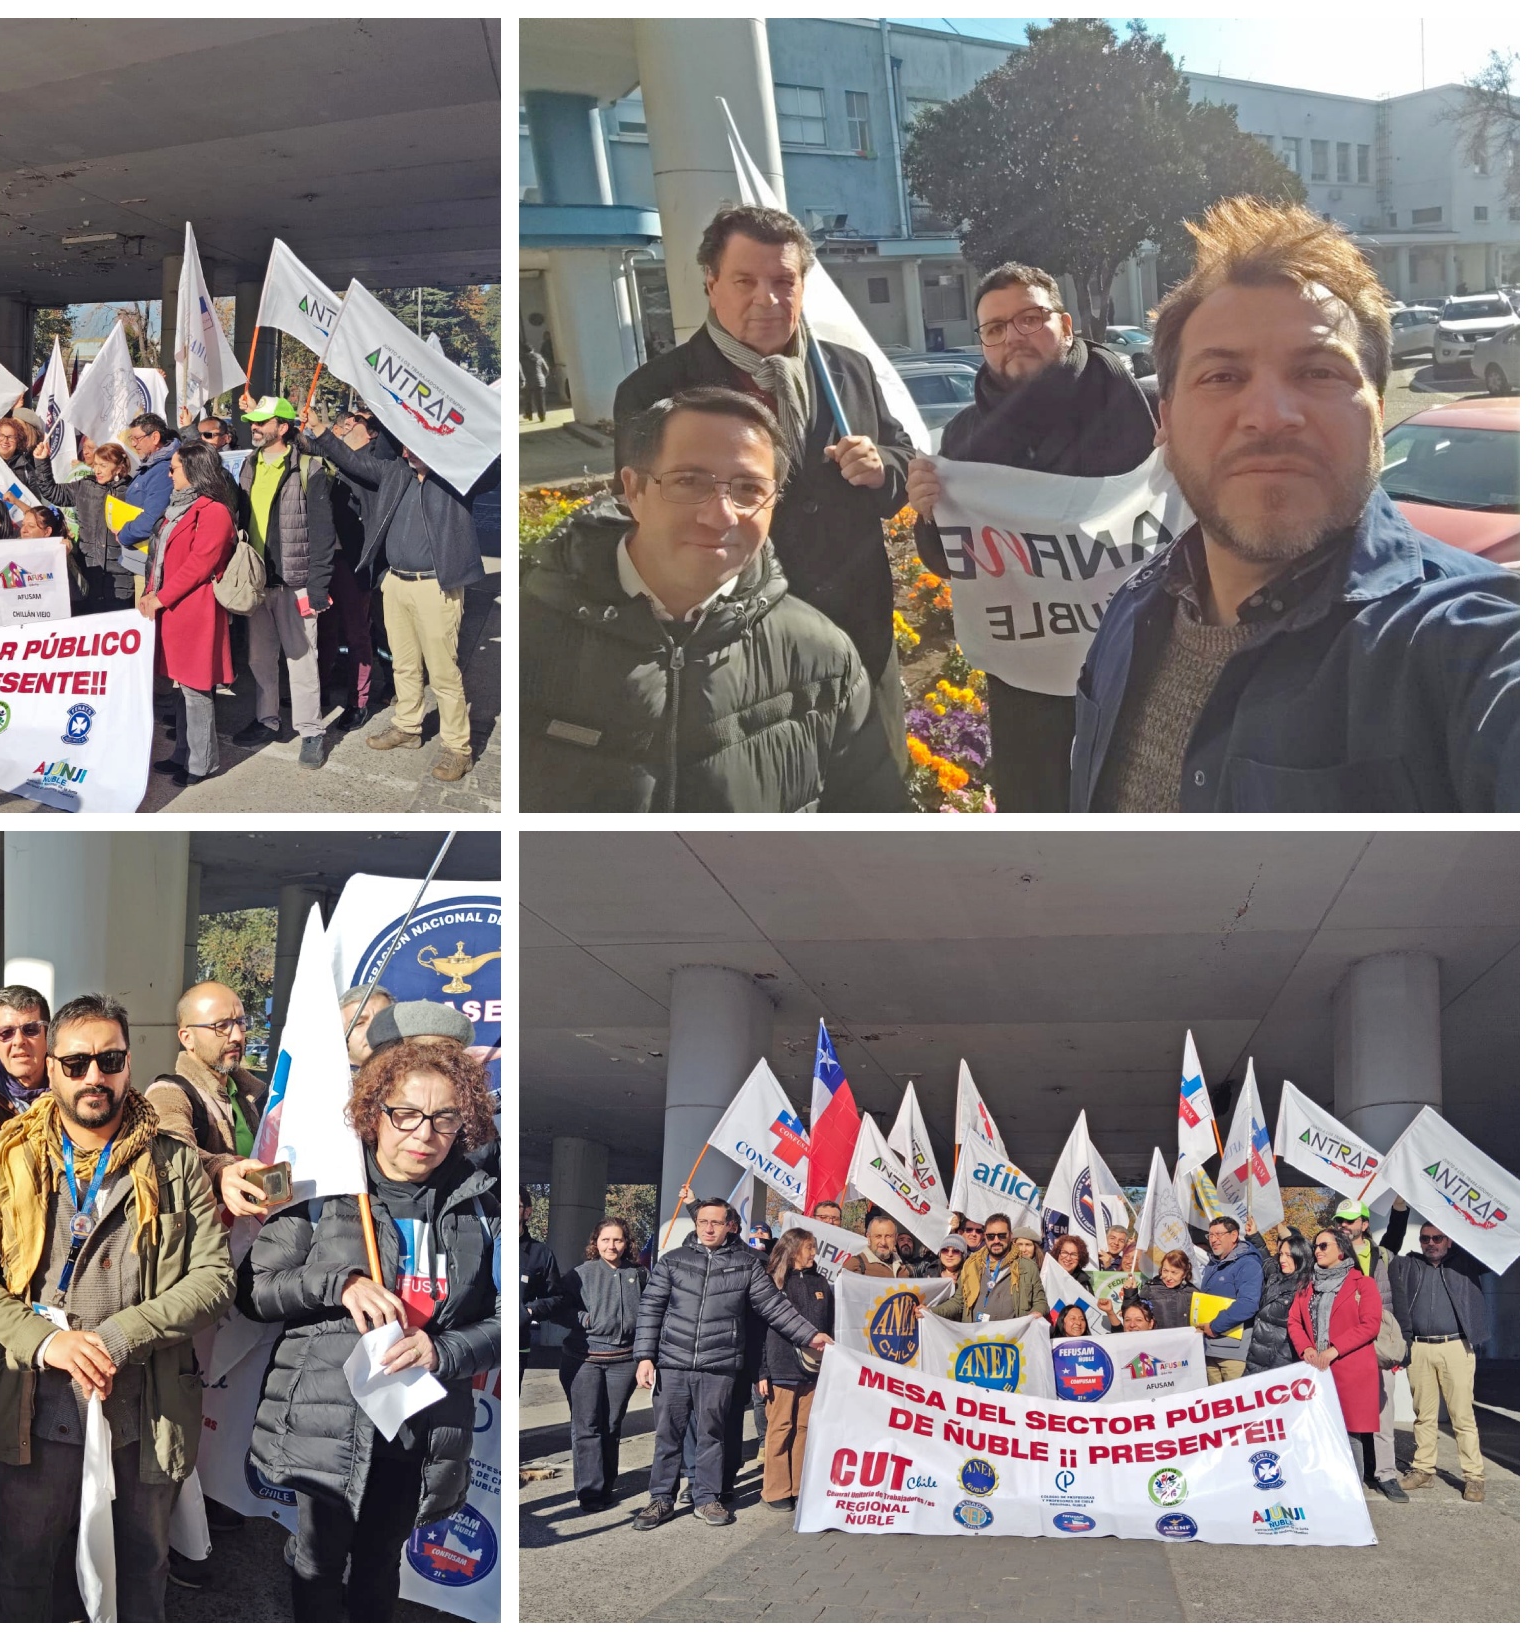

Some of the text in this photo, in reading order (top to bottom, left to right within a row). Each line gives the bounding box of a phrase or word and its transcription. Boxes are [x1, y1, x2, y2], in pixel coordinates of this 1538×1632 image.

[364, 347, 465, 427] ANTRAP
[12, 609, 36, 619] CHILLÁN
[23, 628, 142, 662] PÚBLICO
[33, 761, 88, 784] AJUNJI
[411, 912, 483, 937] NACIONAL
[1298, 1127, 1379, 1179] ANTRAP
[736, 1140, 807, 1196] CONFUSA
[870, 1157, 932, 1215] ANTRAP
[1423, 1160, 1508, 1225] ANTRAP
[879, 1338, 916, 1362] CHILE
[959, 1344, 1017, 1379] ANEF
[1059, 1346, 1095, 1357] FEFUSAM
[1160, 1359, 1189, 1370] AFUSAM
[1146, 1381, 1174, 1391] AFUSAM
[858, 1366, 1316, 1435] MESA DEL SECTOR PÚBLICO
[888, 1407, 1286, 1465] DE ÑUBLE PRESENTE!!
[829, 1448, 913, 1491] CUT
[964, 1461, 994, 1478] ANEF
[906, 1475, 938, 1490] Chile
[258, 1486, 291, 1503] CHILE
[835, 1499, 910, 1514] REGIONAL
[1252, 1506, 1306, 1524] AJUNJI
[845, 1512, 894, 1526] ÑUBLE
[431, 1547, 468, 1566] CONFUSAM
